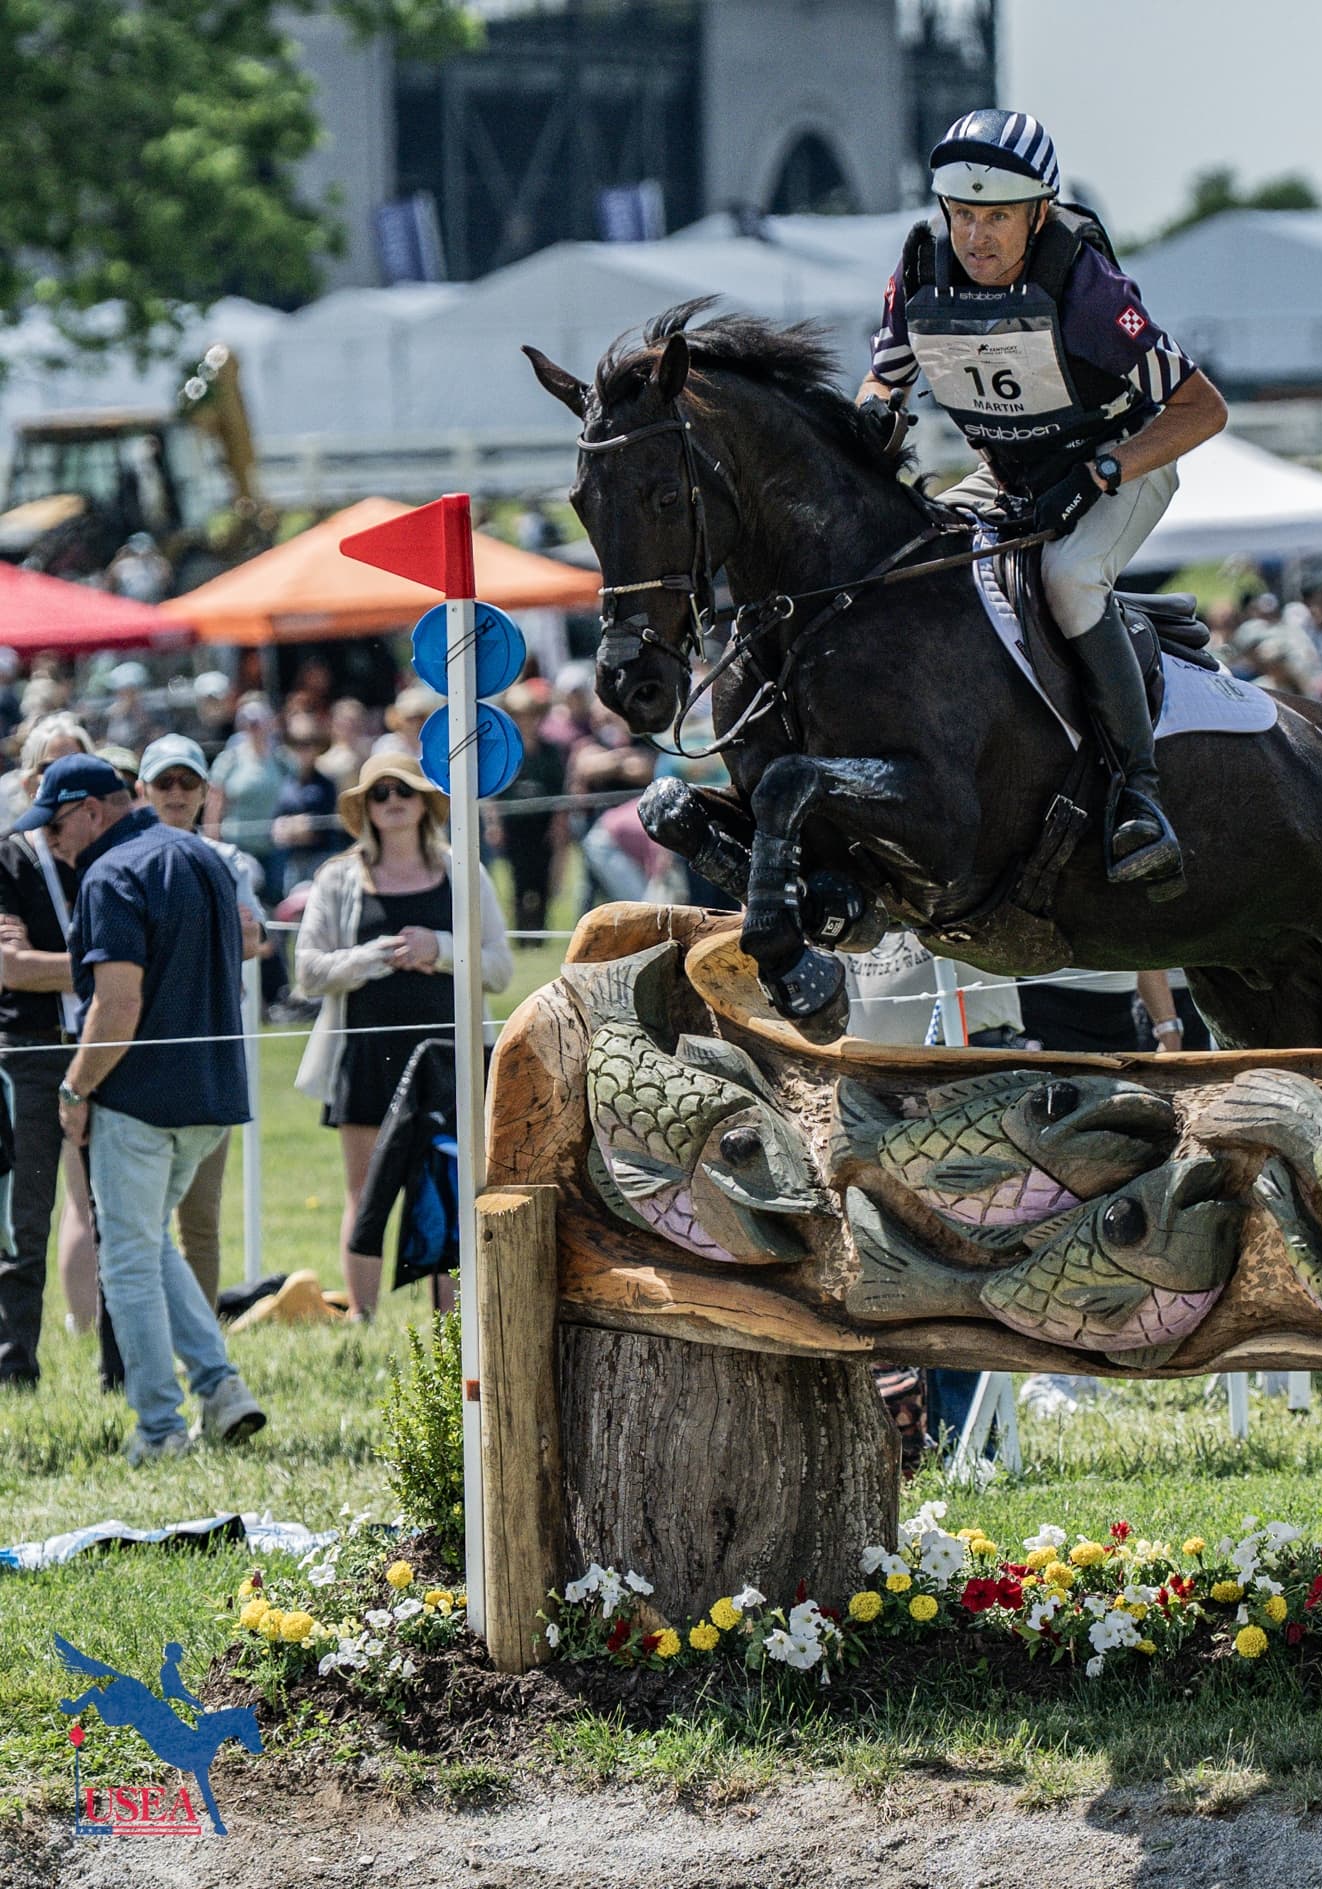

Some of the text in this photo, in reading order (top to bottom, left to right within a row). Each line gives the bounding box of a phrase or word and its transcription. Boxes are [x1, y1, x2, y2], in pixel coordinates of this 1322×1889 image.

[964, 366, 1022, 400] 16
[973, 399, 1025, 413] MARTIN
[1061, 493, 1083, 521] ARIAT
